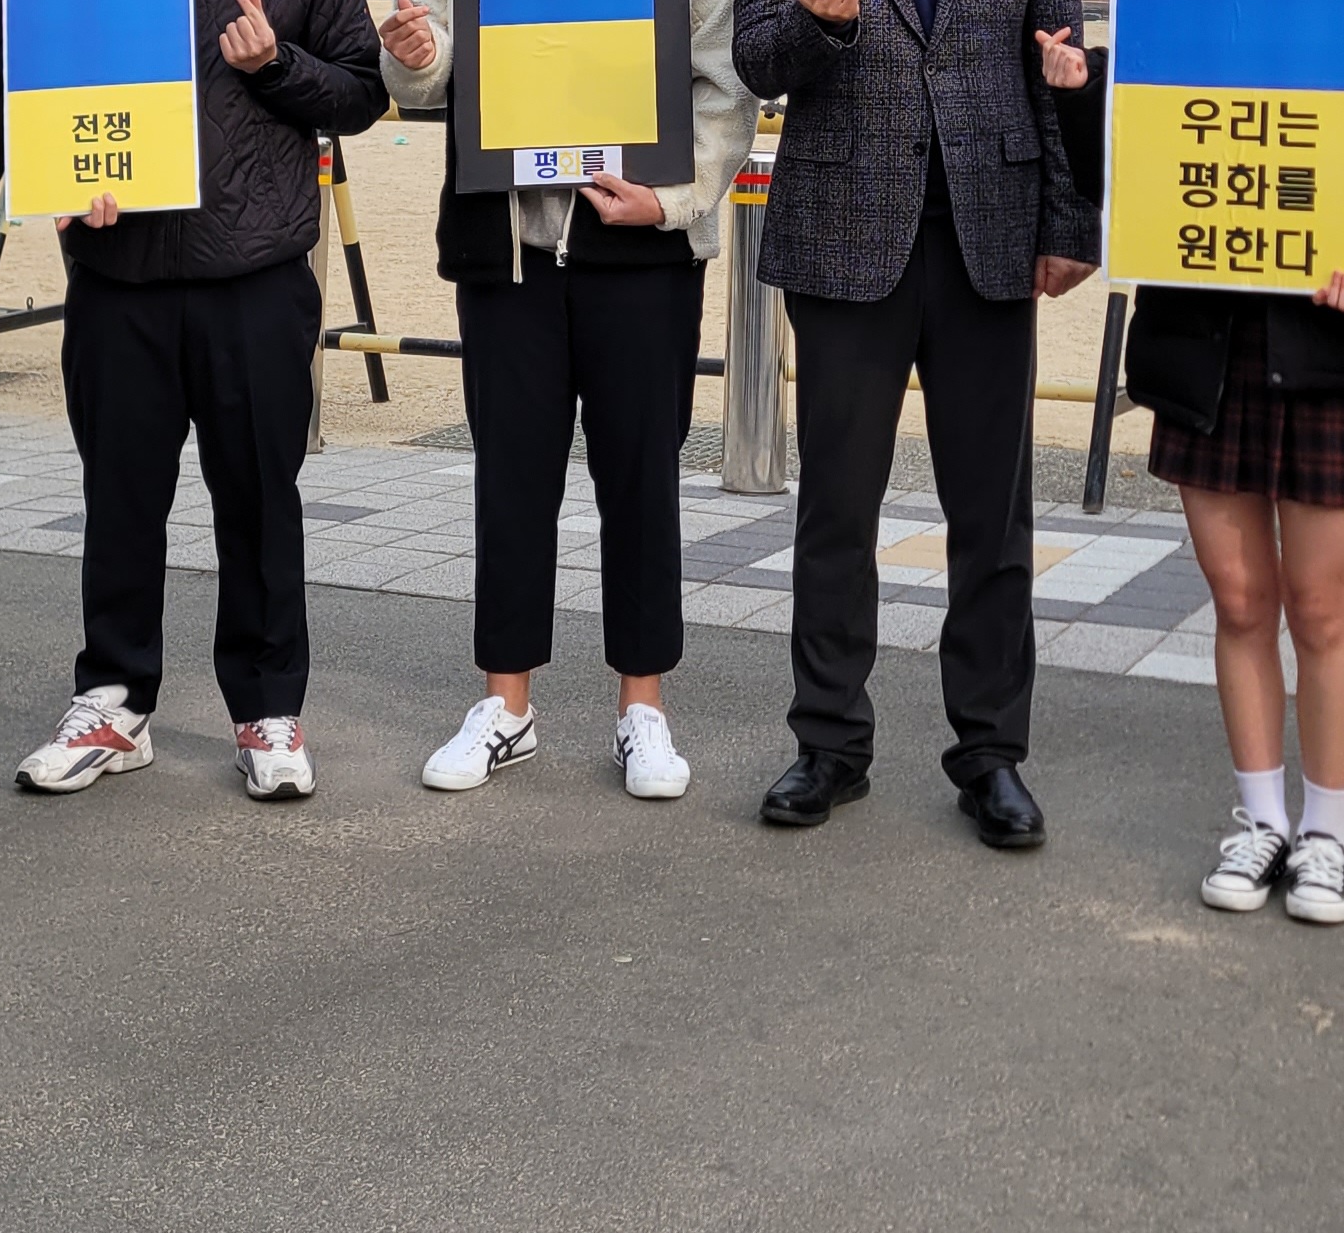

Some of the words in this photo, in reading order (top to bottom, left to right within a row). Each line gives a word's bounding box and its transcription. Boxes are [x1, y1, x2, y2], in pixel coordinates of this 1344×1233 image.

[71, 111, 132, 143] 전쟁
[1181, 98, 1319, 148] 우리는
[72, 150, 134, 183] 반대
[534, 150, 605, 179] 평화를
[1179, 161, 1318, 213] 평화를
[1177, 223, 1318, 276] 원한다
